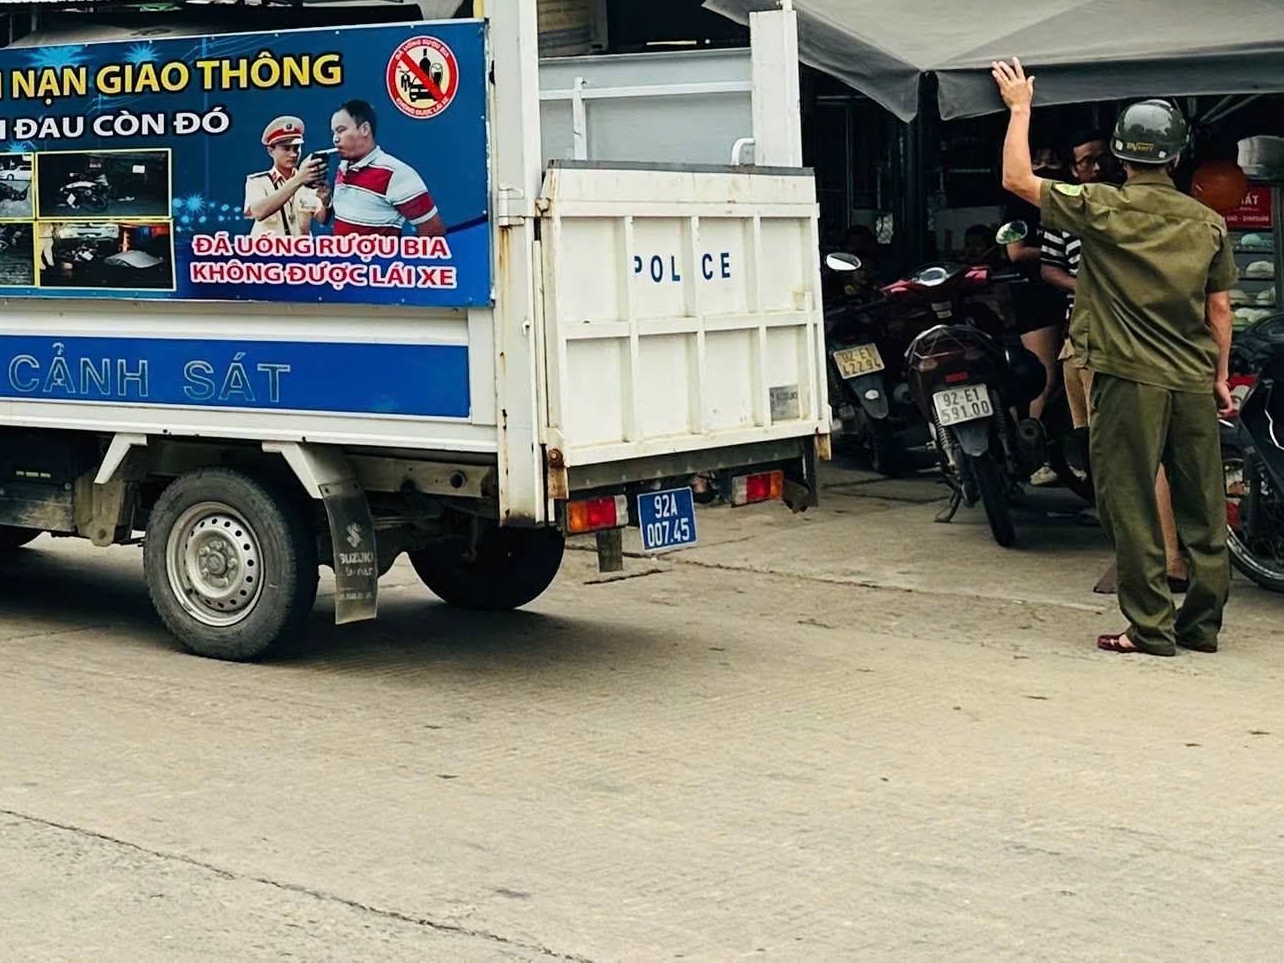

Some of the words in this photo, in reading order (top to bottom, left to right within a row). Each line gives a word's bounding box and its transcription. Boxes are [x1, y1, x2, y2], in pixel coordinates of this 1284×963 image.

[12, 66, 87, 106] NẠN
[96, 61, 190, 95] GIAO
[196, 51, 342, 90] THÔNG
[13, 116, 85, 140] ĐAU
[93, 110, 165, 137] CÒN
[173, 106, 230, 135] ĐÓ
[193, 232, 234, 256] ĐÃ
[236, 232, 314, 256] UỐNG
[318, 232, 397, 262] RƯỢU
[402, 236, 450, 258] BIA
[191, 259, 282, 284] KHÔNG
[286, 261, 365, 289] ĐƯỢC
[370, 264, 414, 287] LÁI
[418, 266, 457, 288] XE
[8, 341, 149, 398] CẢNH
[182, 351, 292, 404] SÁT
[653, 492, 678, 519] 92A
[646, 517, 691, 547] 007.45
